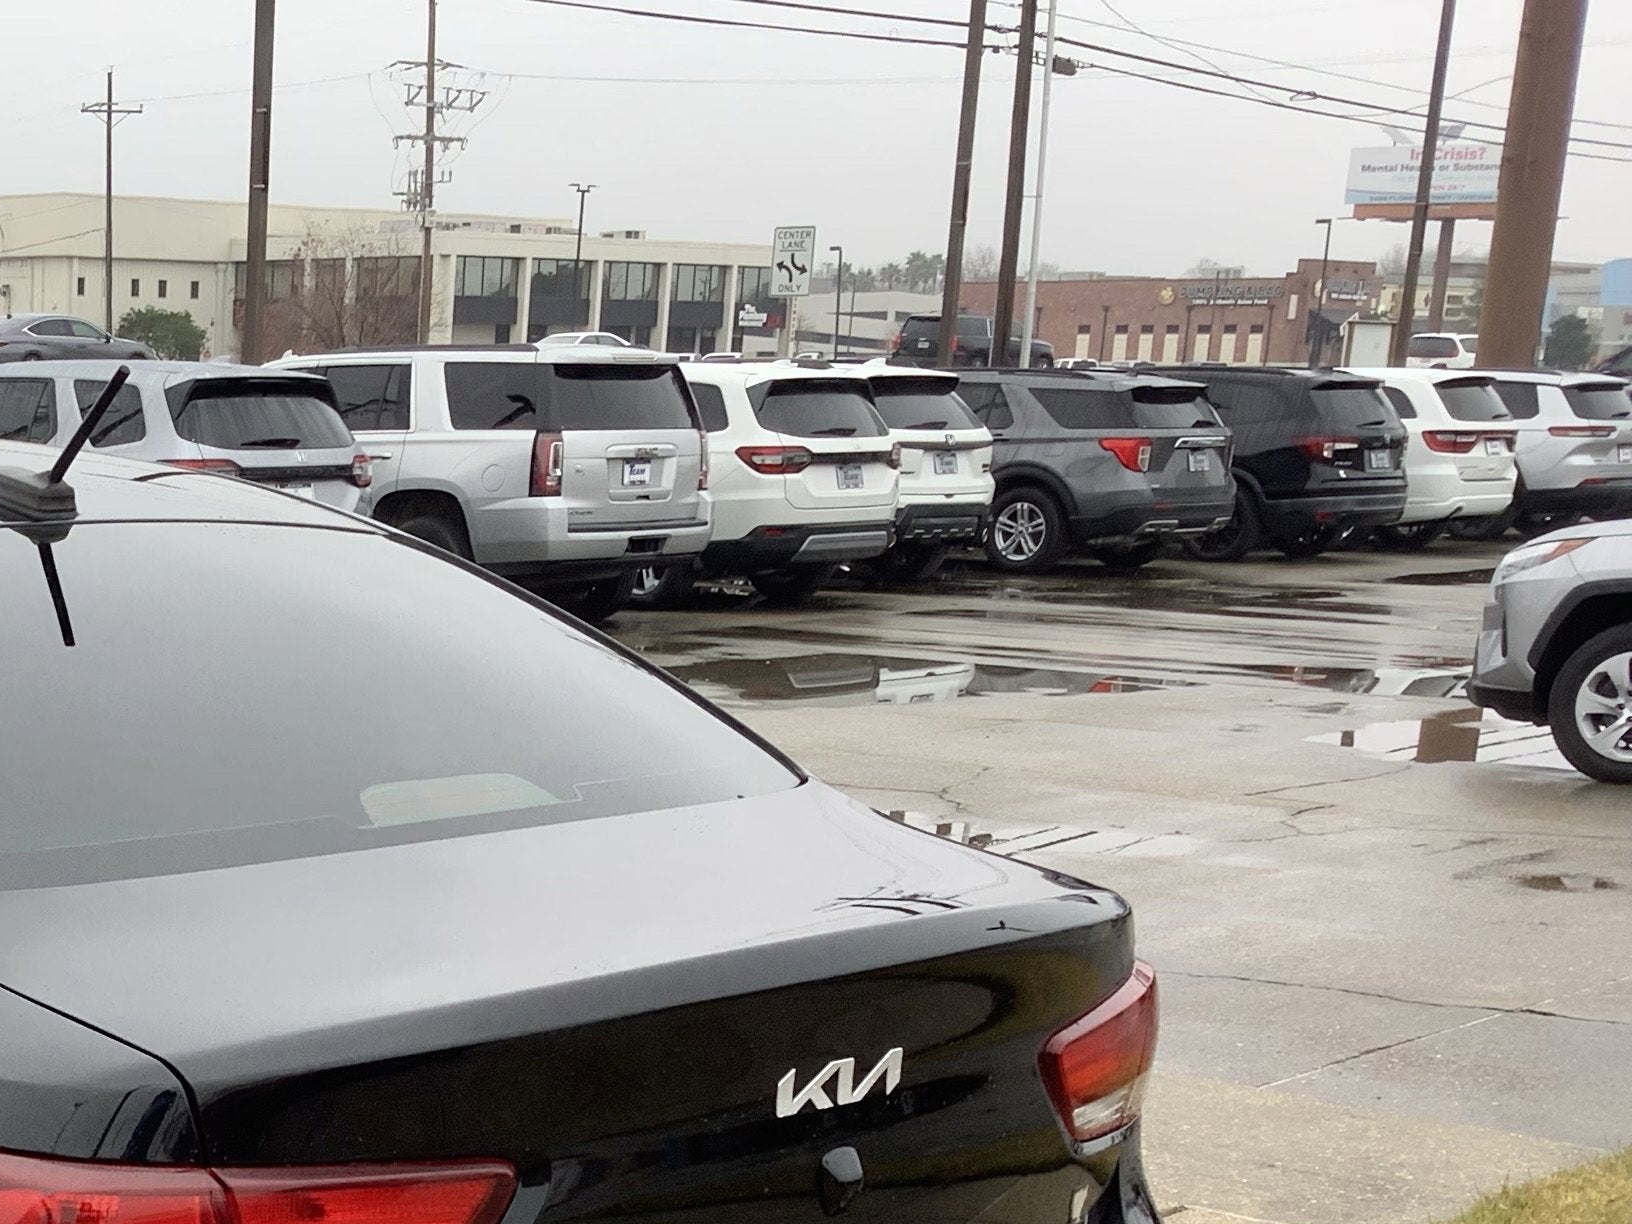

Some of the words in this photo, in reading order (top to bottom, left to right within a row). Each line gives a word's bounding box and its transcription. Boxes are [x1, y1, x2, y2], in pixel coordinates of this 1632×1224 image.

[1434, 147, 1487, 161] Crisis?
[1361, 164, 1397, 173] Mental
[777, 230, 812, 240] CENTER
[782, 240, 807, 249] LANE
[778, 284, 802, 293] ONLY
[776, 1047, 904, 1118] KIA
